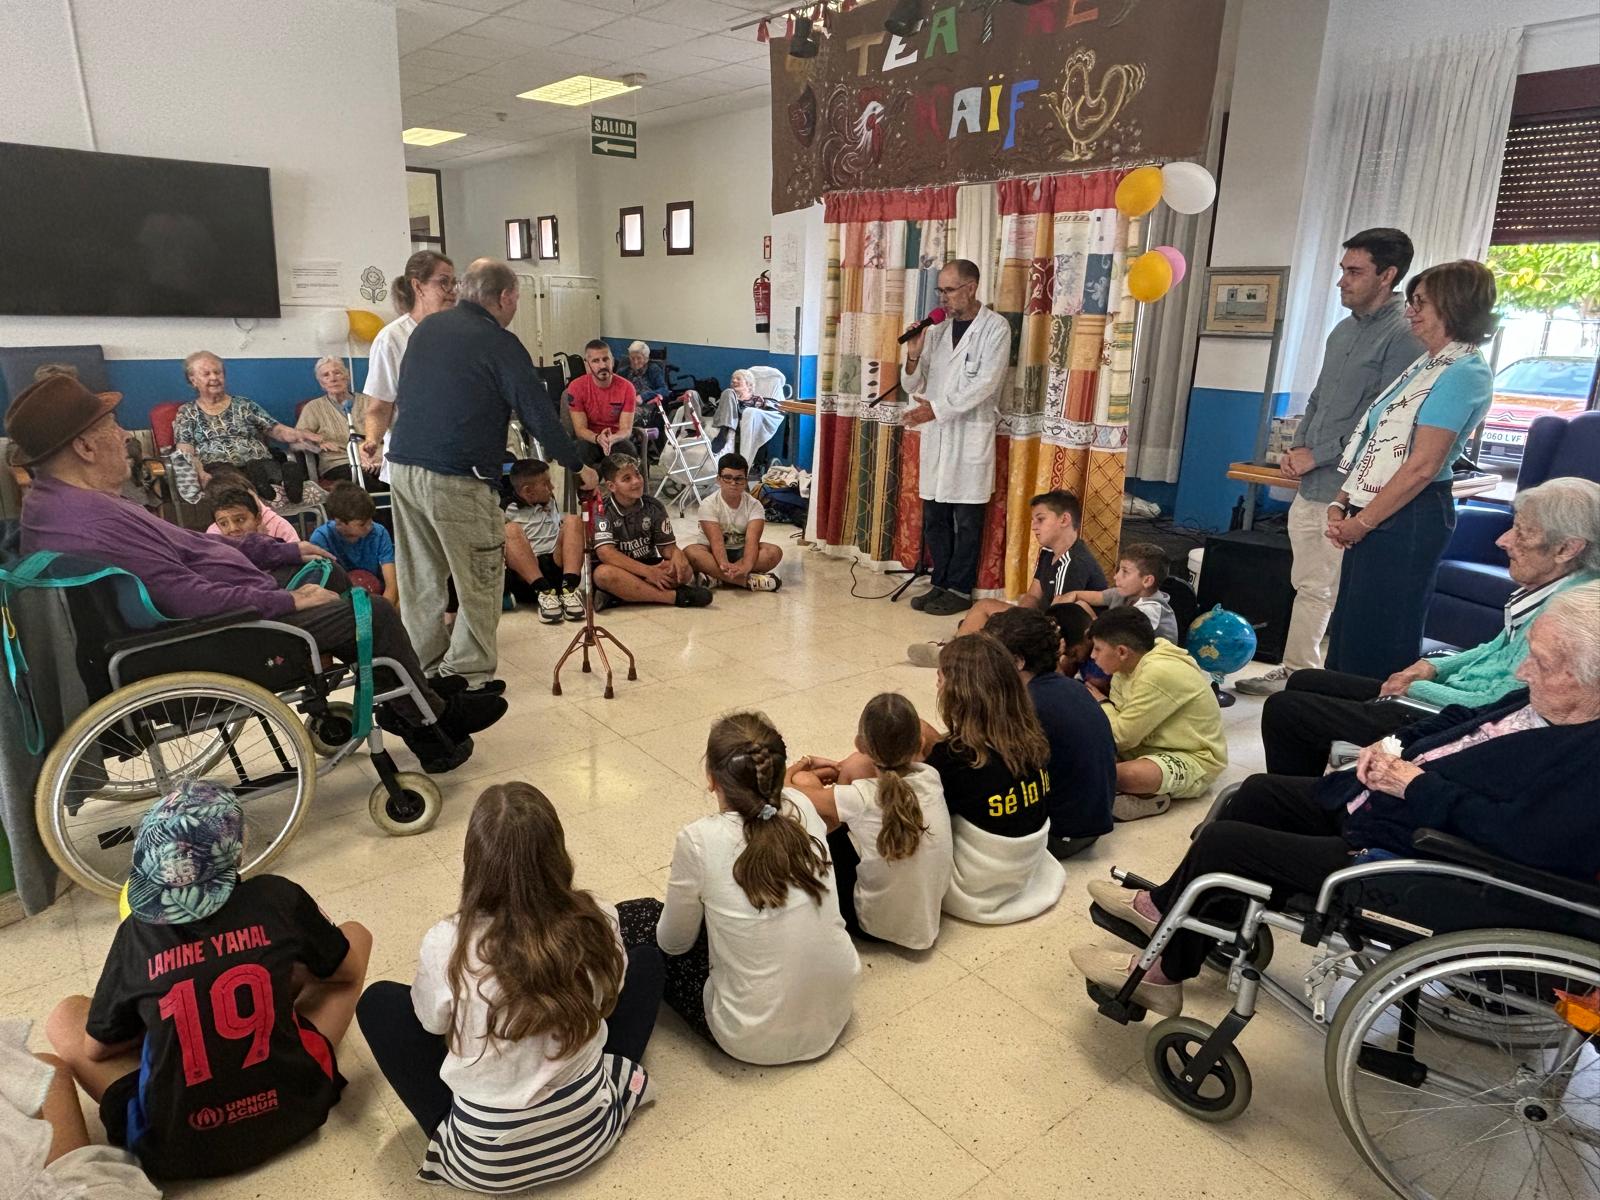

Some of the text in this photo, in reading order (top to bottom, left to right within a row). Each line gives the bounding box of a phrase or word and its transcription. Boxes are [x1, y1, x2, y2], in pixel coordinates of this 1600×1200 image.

[594, 118, 634, 136] SALIDA
[988, 787, 1018, 817] Sé
[147, 925, 272, 981] LAMINE YAMAL
[158, 963, 275, 1088] 19
[225, 1088, 278, 1112] UNHCR
[227, 1098, 279, 1121] ACNUR
